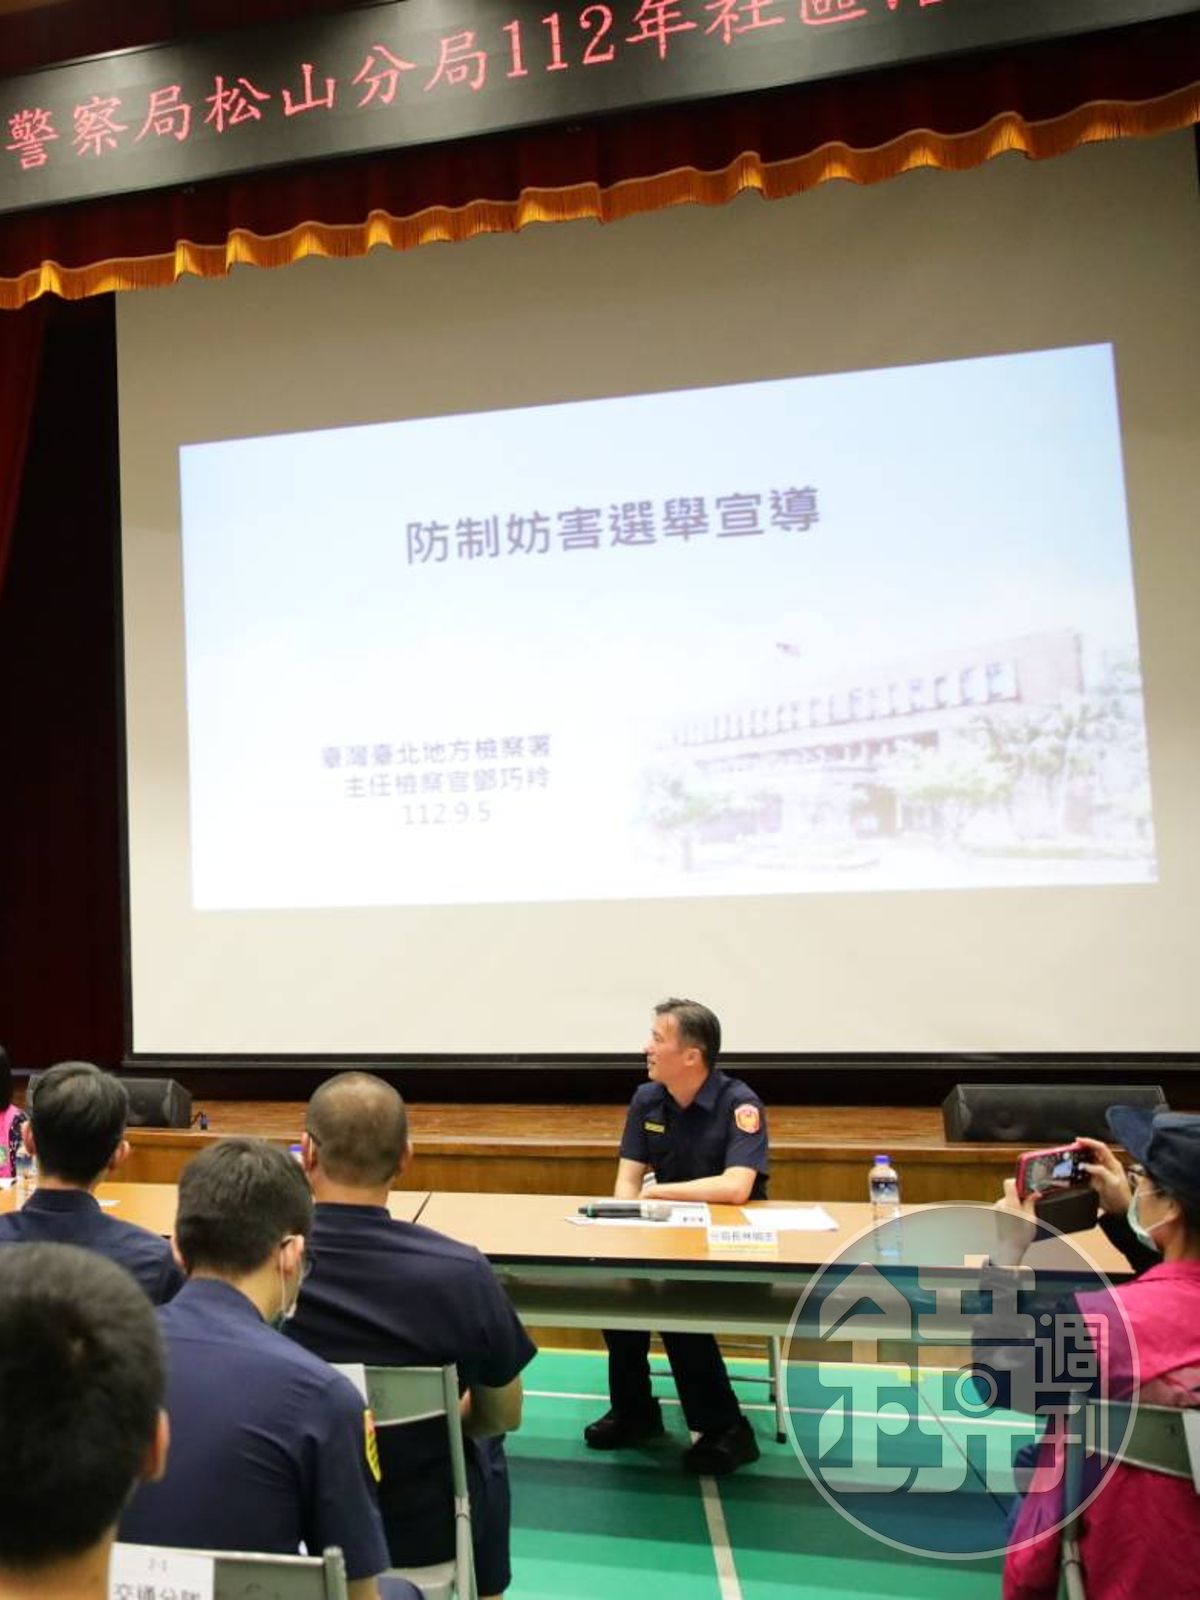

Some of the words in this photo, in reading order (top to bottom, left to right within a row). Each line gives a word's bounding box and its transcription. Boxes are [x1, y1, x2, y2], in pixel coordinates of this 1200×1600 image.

[405, 485, 821, 565] 防制妨害選舉宣導
[322, 734, 552, 769] 臺灣臺北地方檢察署
